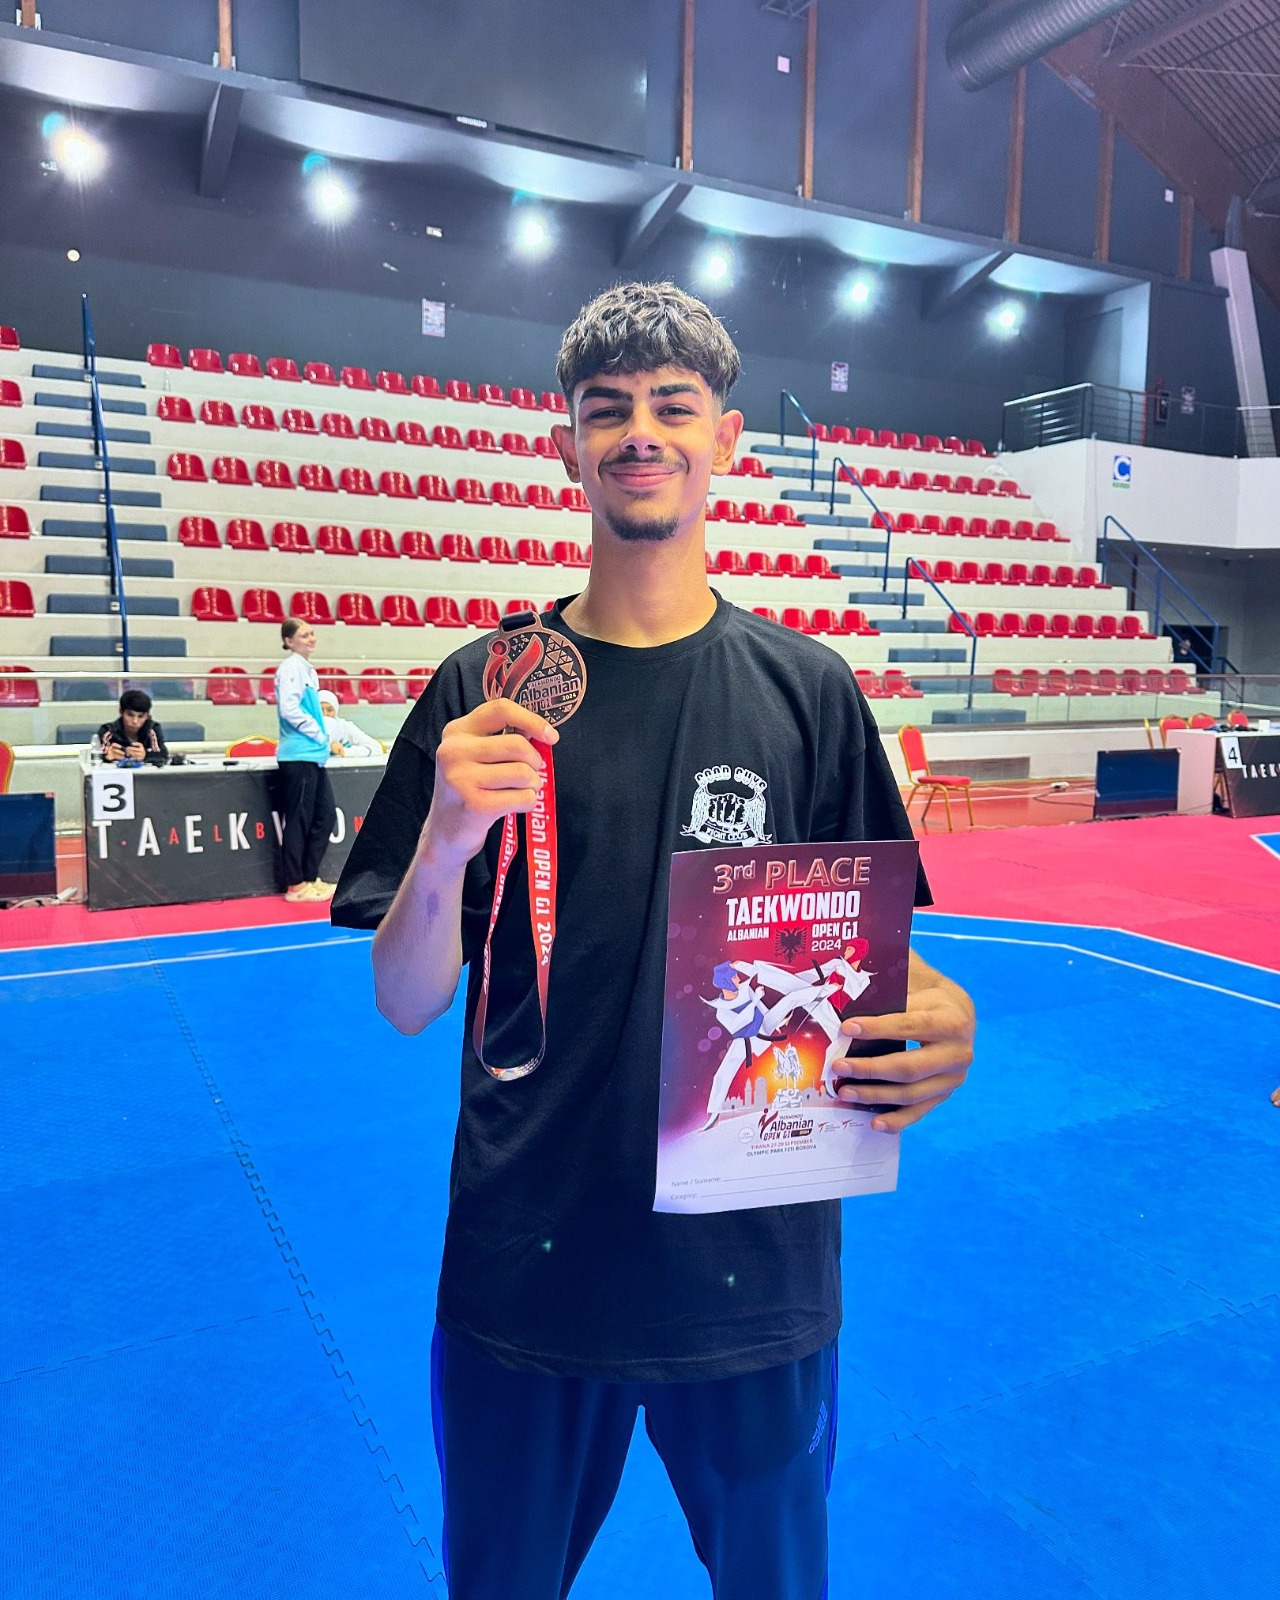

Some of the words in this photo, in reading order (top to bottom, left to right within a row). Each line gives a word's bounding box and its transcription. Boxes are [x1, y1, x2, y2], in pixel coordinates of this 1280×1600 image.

[1114, 457, 1130, 480] C
[521, 680, 579, 703] Albanian
[1228, 746, 1238, 764] 4
[102, 783, 127, 812] 3
[533, 848, 550, 891] OPEN
[713, 860, 756, 894] 3rd
[766, 857, 872, 890] PLACE
[535, 897, 550, 915] G1
[726, 891, 861, 926] TAEKWONDO
[727, 927, 770, 942] ALBANIAN
[812, 923, 840, 938] OPEN
[842, 921, 858, 940] G1
[537, 922, 553, 966] 2024
[811, 939, 842, 952] 2024
[770, 1119, 814, 1132] Albanian
[747, 1148, 769, 1157] OLYMPIC
